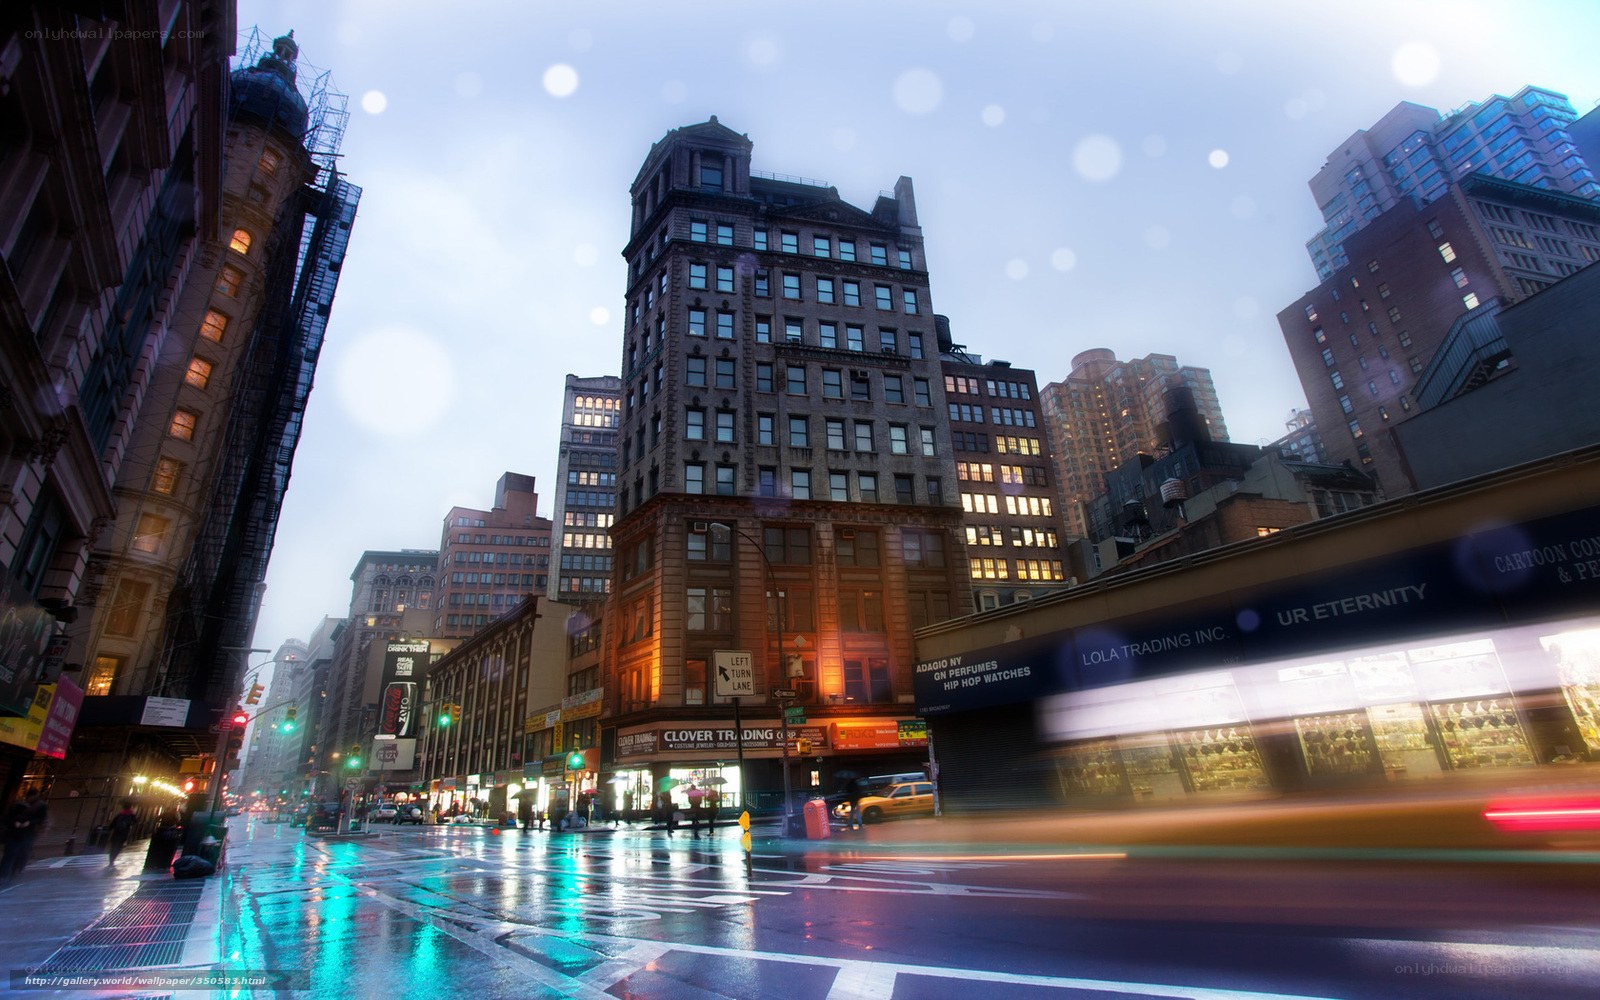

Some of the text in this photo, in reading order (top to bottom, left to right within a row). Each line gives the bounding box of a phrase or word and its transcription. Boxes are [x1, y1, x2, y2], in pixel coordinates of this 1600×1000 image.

[1494, 544, 1568, 574] CARTOON
[1557, 566, 1573, 583] &
[1277, 582, 1427, 627] UR ETERNITY
[1082, 626, 1231, 666] LOLA TRADING INC.
[730, 657, 749, 666] LEFT
[916, 656, 962, 674] ADAGIO NY
[731, 669, 752, 679] TURN
[934, 660, 998, 681] GN PERFUMES
[944, 666, 1031, 691] HIP HOP WATCHES
[732, 682, 752, 691] LANE
[618, 735, 635, 747] CLOVER
[664, 730, 714, 742] CLOVER
[716, 729, 773, 741] TRADING
